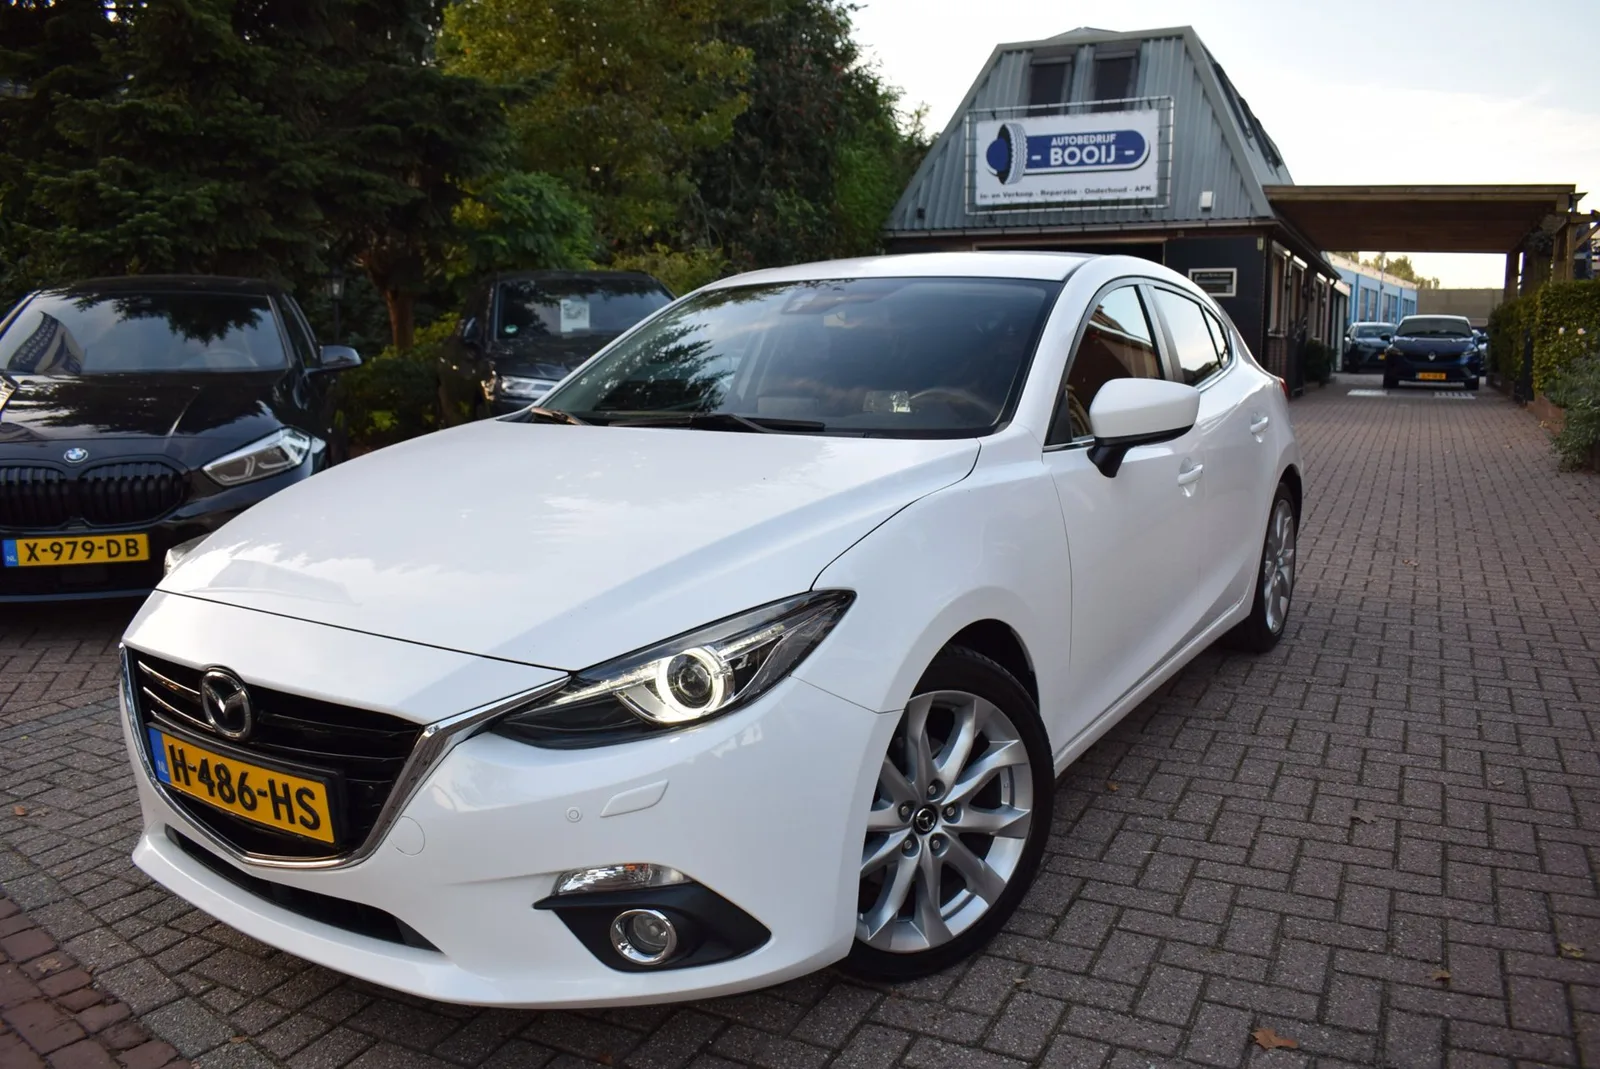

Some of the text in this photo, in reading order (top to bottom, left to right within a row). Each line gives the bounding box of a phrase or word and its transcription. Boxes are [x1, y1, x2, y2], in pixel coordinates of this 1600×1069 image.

[1051, 133, 1117, 146] AUTOBEDRIJF
[1050, 145, 1116, 166] BOOIJ
[1003, 190, 1034, 198] Verkoop
[1040, 188, 1078, 197] Reparatie
[1084, 185, 1128, 195] Onderhoud
[1134, 183, 1152, 192] APK
[25, 538, 140, 562] X-979-DB
[168, 743, 321, 832] H-486-HS
